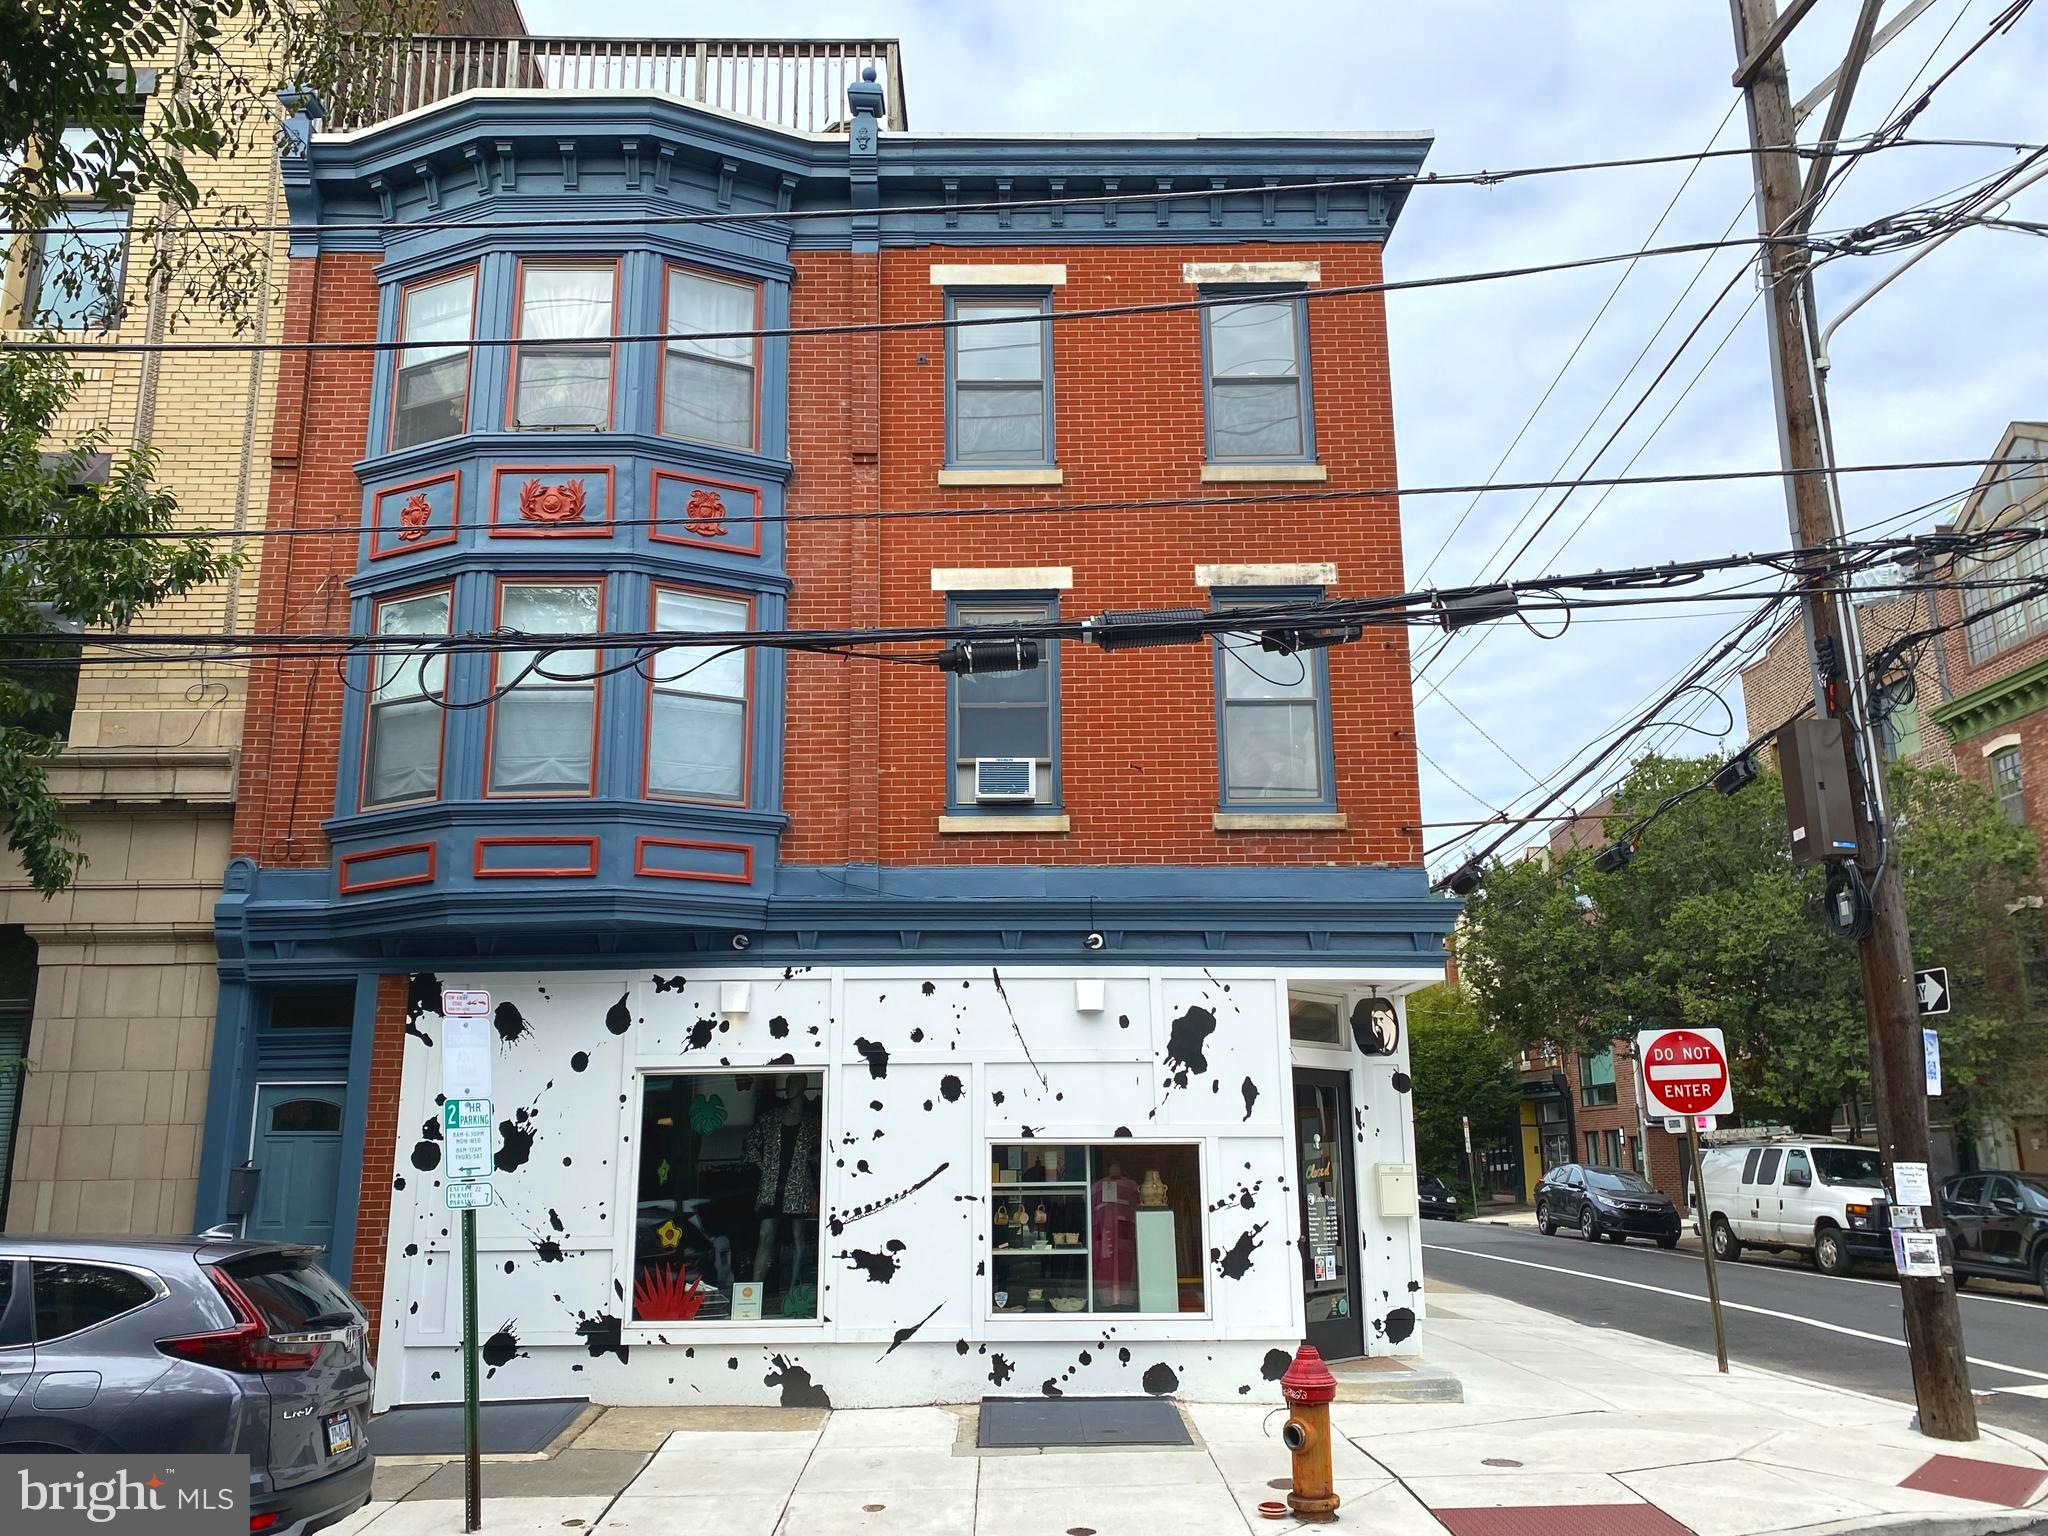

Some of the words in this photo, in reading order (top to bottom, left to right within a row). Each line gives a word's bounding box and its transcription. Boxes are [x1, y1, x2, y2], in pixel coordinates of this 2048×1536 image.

[1654, 1047, 1674, 1060] DO
[1682, 1046, 1711, 1059] NOT
[1664, 1083, 1712, 1098] ENTER
[448, 1105, 456, 1124] 2
[470, 1103, 481, 1112] HR
[460, 1115, 489, 1125] PARKING
[485, 1193, 490, 1203] 7
